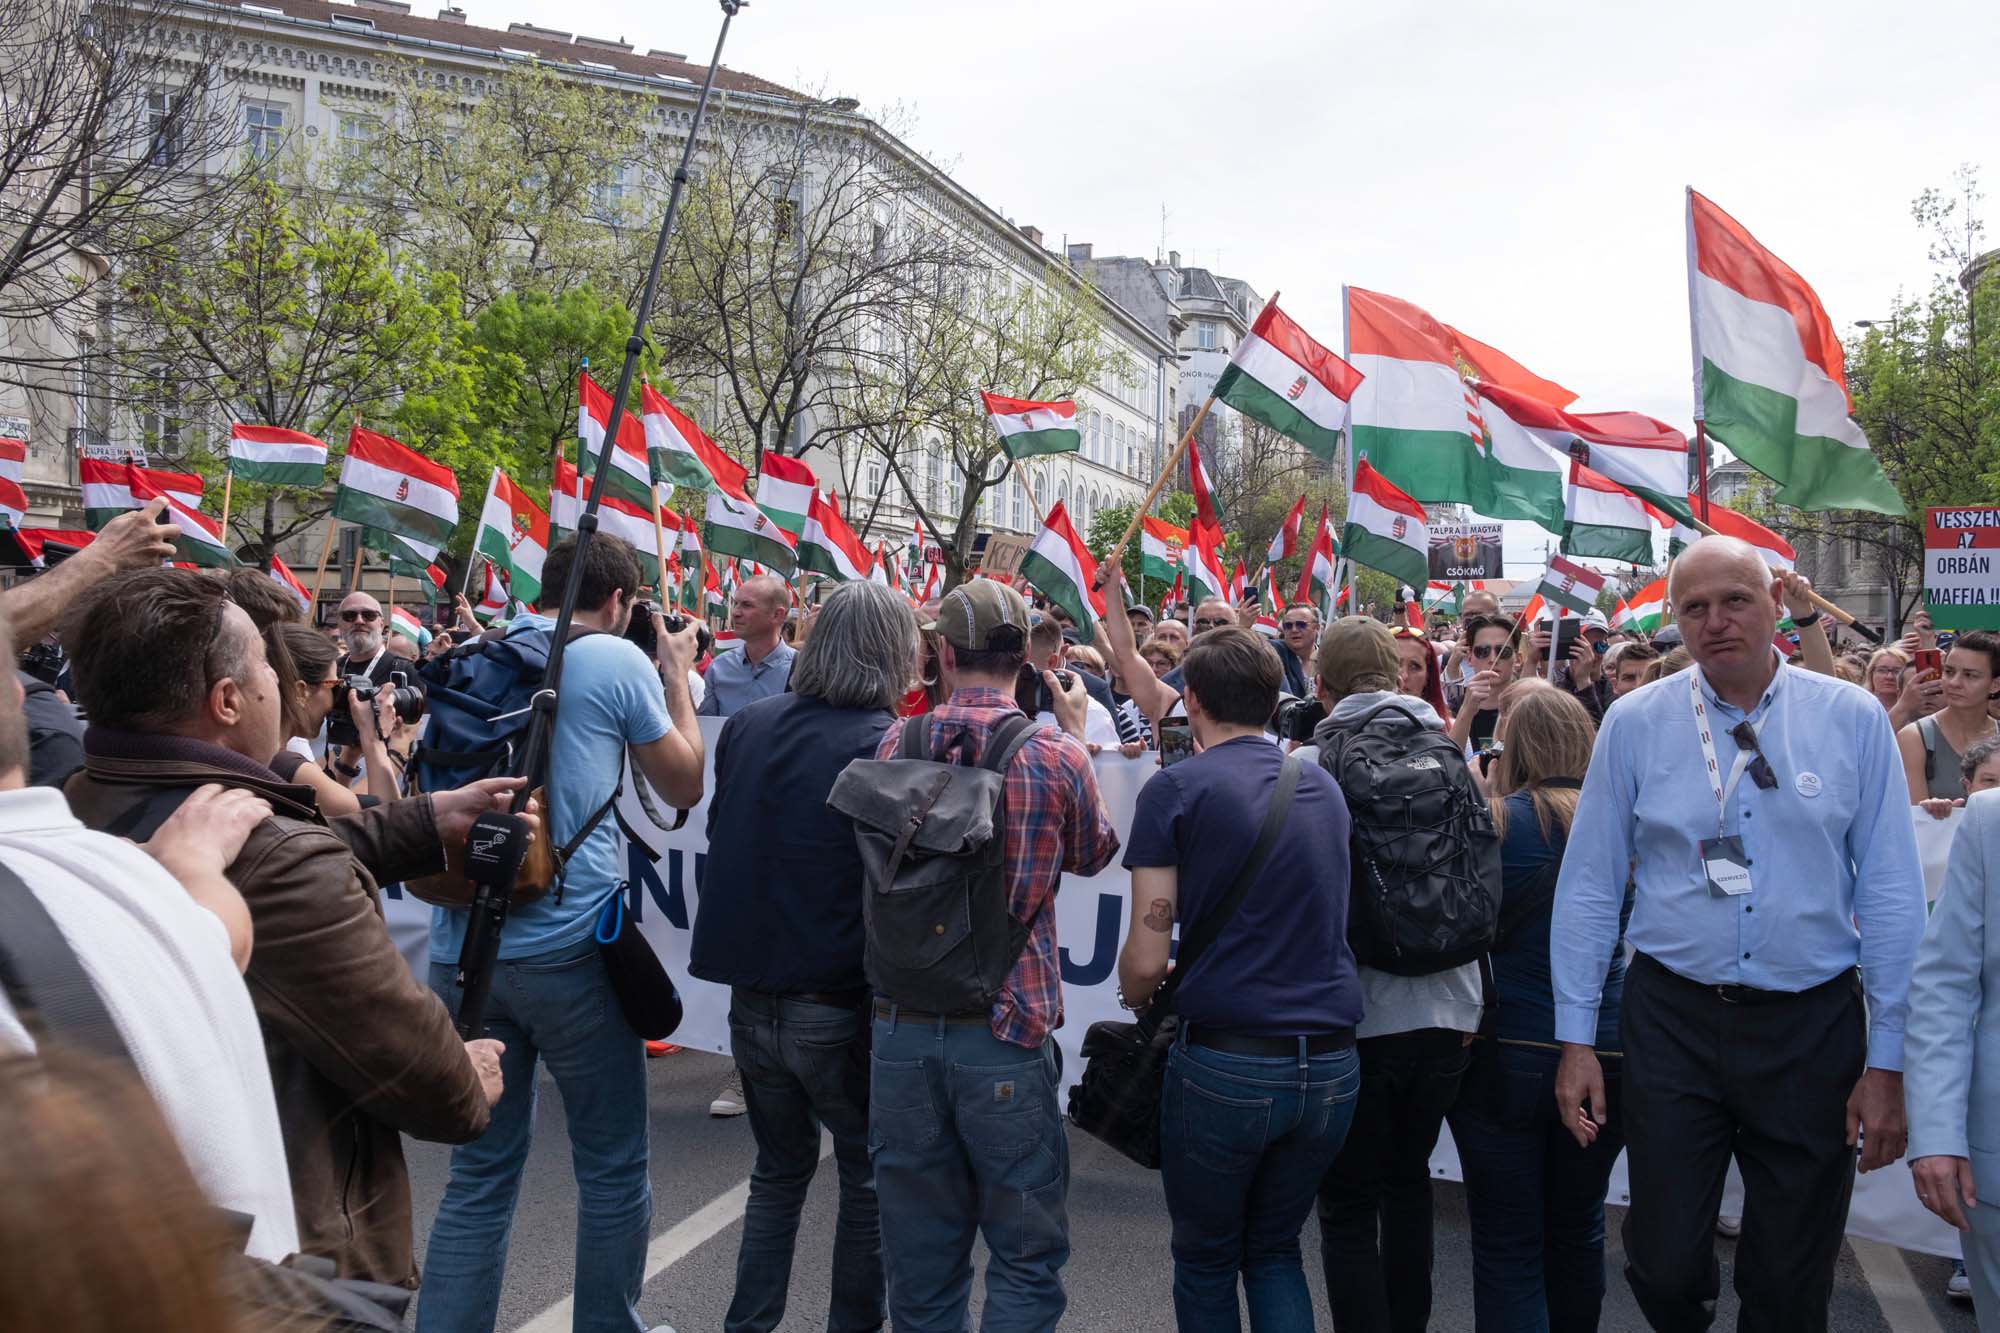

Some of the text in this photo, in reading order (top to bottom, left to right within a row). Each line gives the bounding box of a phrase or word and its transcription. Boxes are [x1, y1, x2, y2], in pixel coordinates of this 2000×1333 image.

[1429, 525, 1502, 535] TALPRA MAGYAR
[1957, 532, 1976, 549] AZ
[1937, 553, 1990, 574] ORBÁN
[1928, 588, 1985, 605] MAFFIA
[627, 842, 707, 930] N
